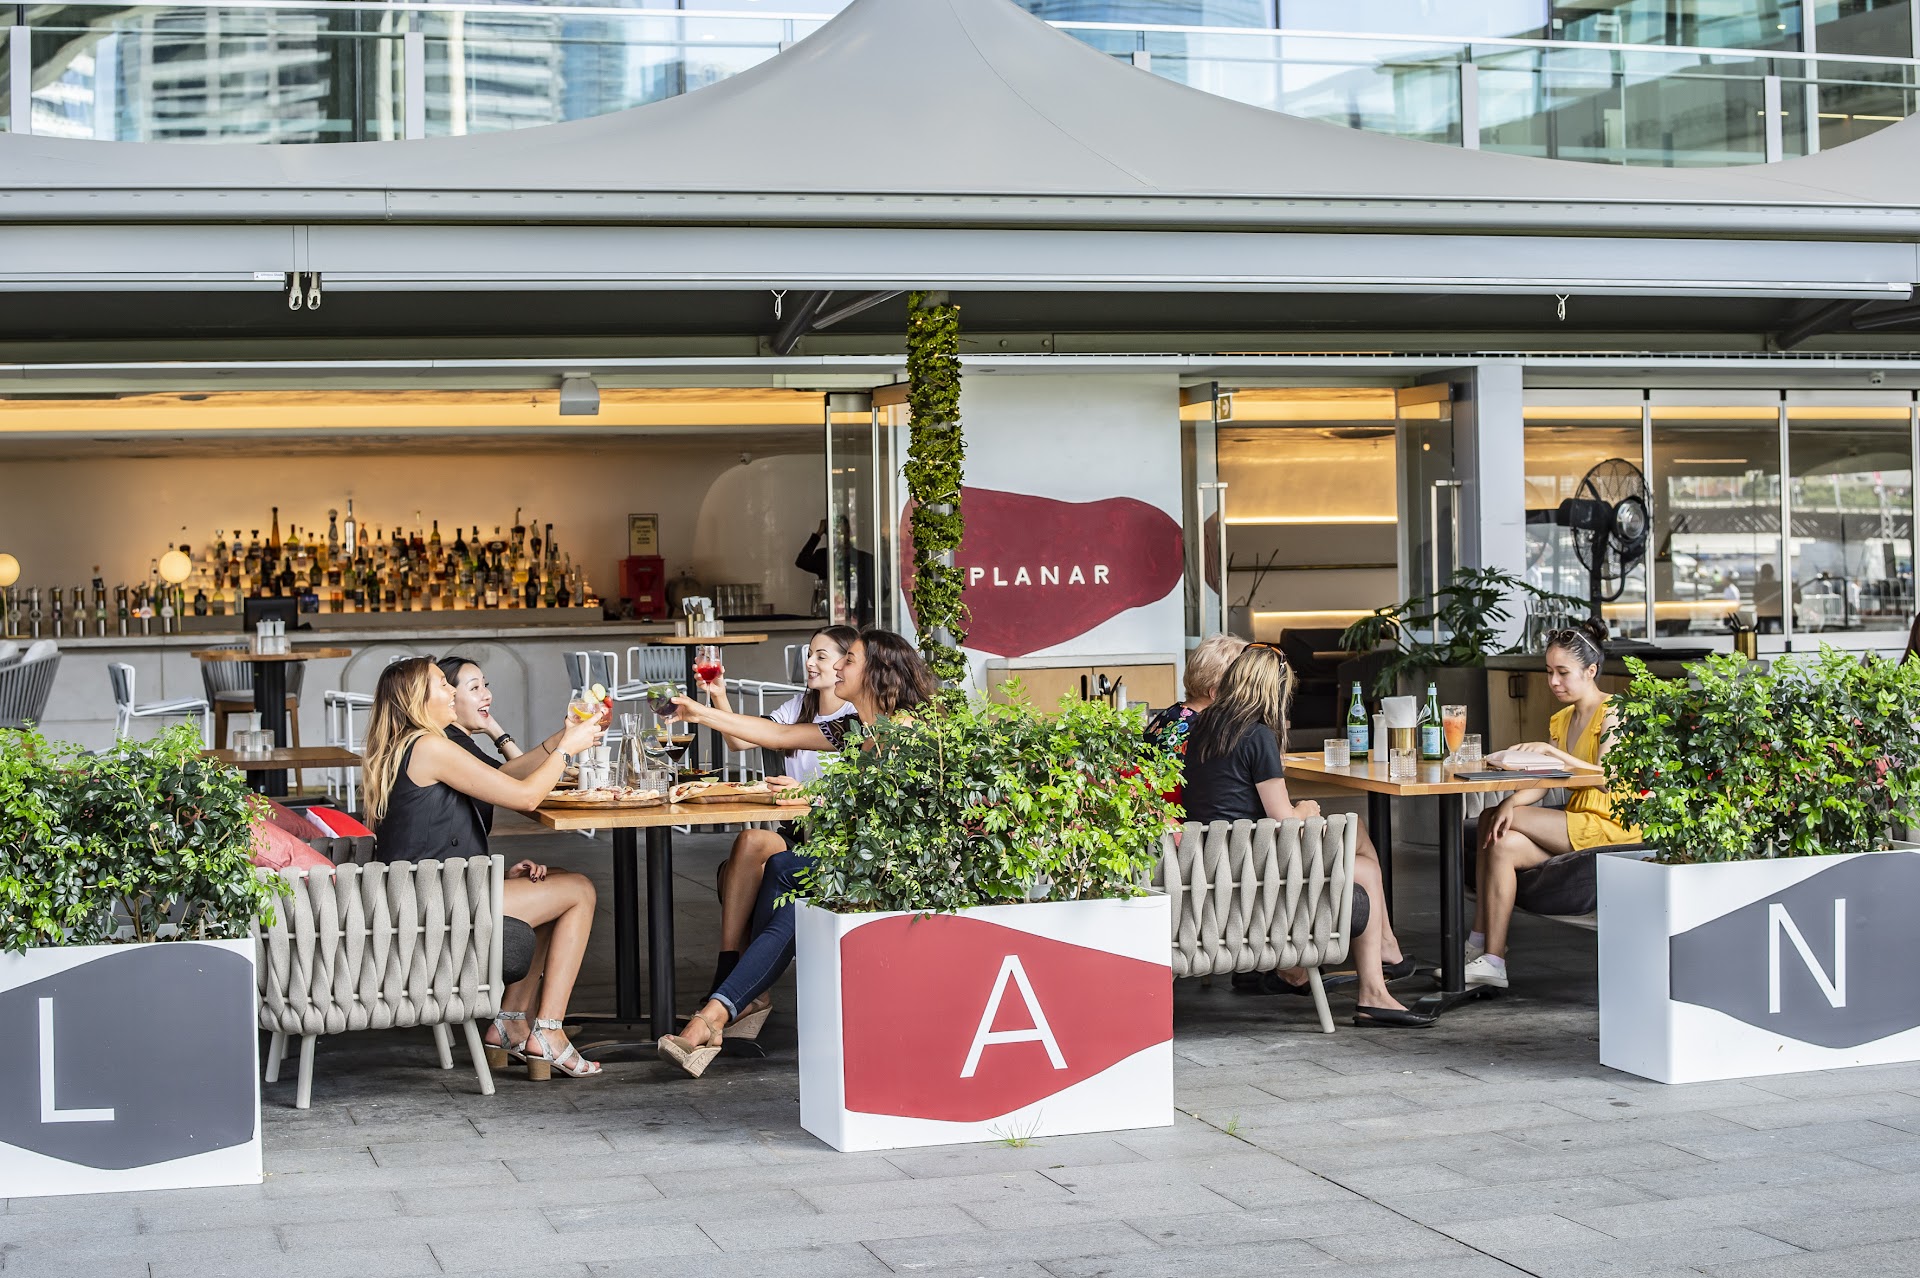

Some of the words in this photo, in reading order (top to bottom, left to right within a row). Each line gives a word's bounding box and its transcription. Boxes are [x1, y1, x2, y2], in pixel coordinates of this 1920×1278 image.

[969, 565, 1110, 587] PLANAR
[1769, 898, 1847, 1014] N
[38, 997, 115, 1123] L
[959, 954, 1069, 1079] A
